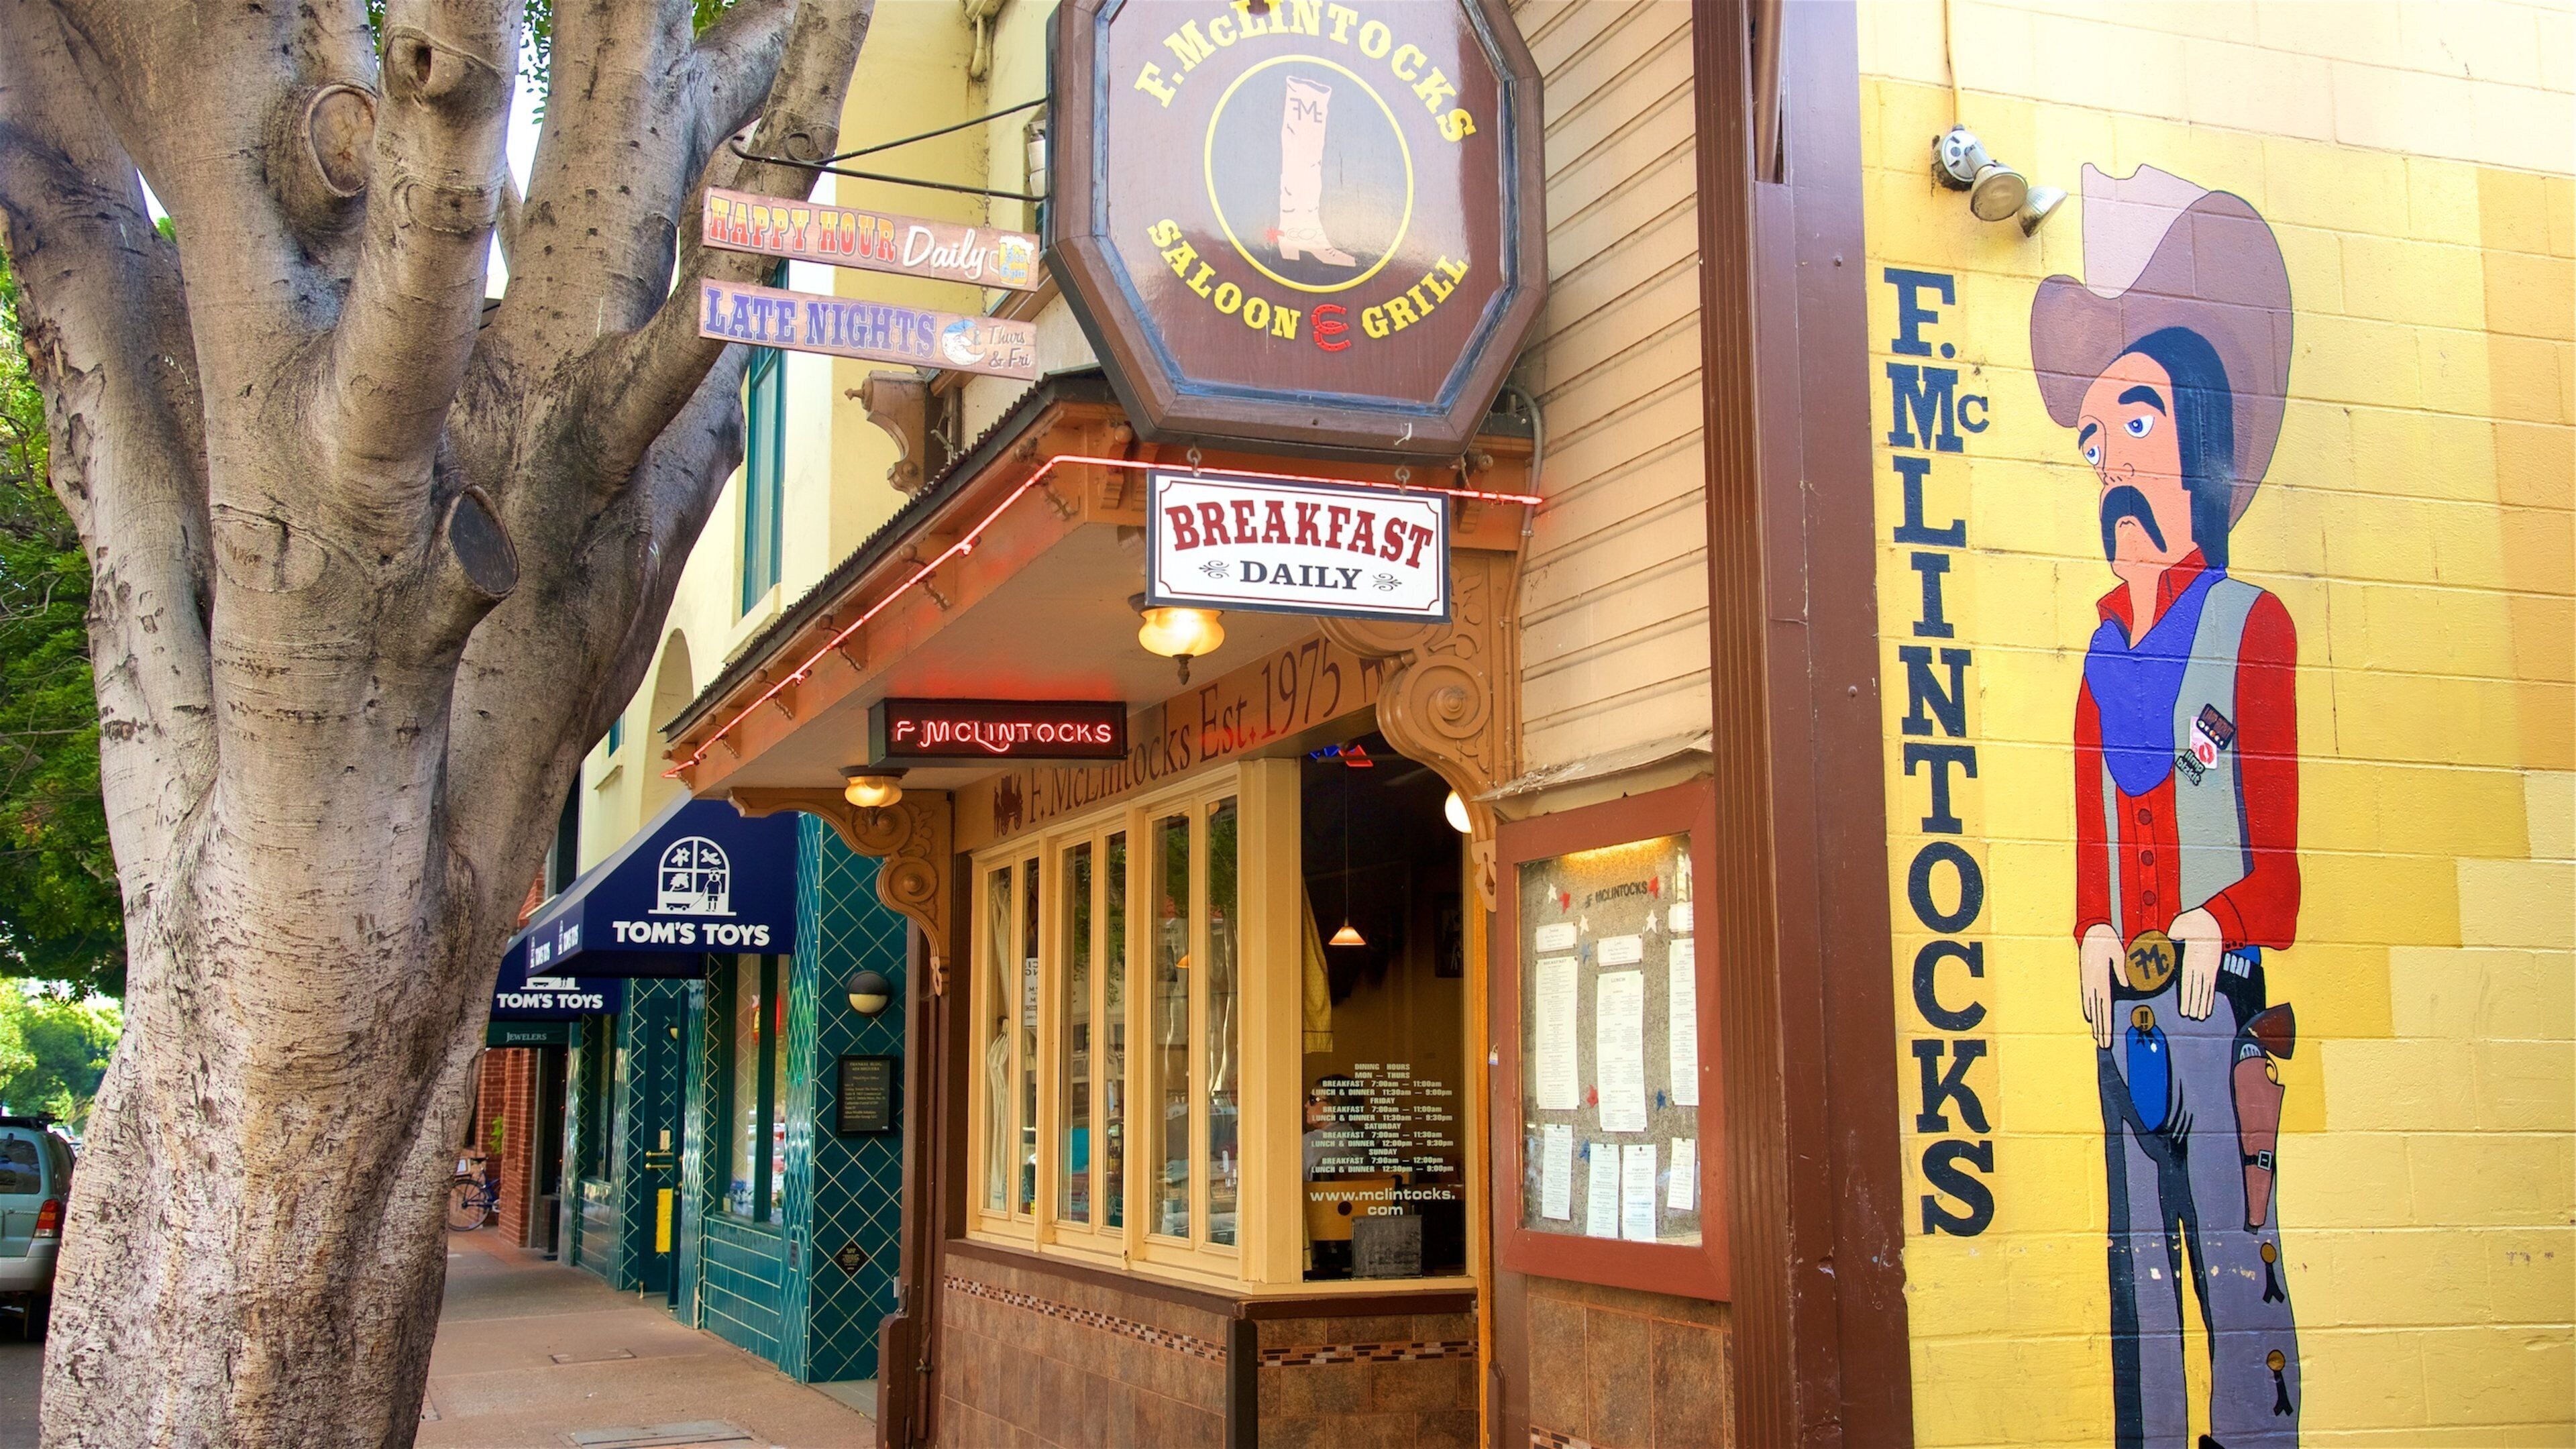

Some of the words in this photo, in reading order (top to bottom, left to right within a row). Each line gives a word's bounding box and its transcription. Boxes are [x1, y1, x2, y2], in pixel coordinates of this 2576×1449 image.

[709, 195, 810, 252] HAPPY
[818, 209, 897, 263] HOUR
[902, 225, 987, 280] Daily
[1146, 218, 1301, 340] SALOON
[1360, 254, 1470, 339] GRILL
[704, 286, 798, 344] LATE
[805, 301, 937, 360] NIGHTS
[987, 325, 1026, 345] Thurs
[989, 350, 1005, 368] &
[1008, 347, 1033, 368] Fri
[1165, 499, 1434, 570] BREAKFAST
[1239, 559, 1363, 590] DAILY
[1199, 682, 1257, 765] Est.
[1261, 637, 1341, 740] 1975
[897, 720, 916, 742] F
[919, 720, 1112, 753] MCLINTOCKS
[612, 920, 696, 945] TOM'S
[702, 923, 771, 947] TOYS
[496, 993, 553, 1010] TOM'S
[557, 994, 603, 1010] TOYS
[506, 1031, 547, 1043] JEWELERS
[1310, 1187, 1455, 1201] www.mclintocks.
[1368, 1205, 1403, 1216] com
